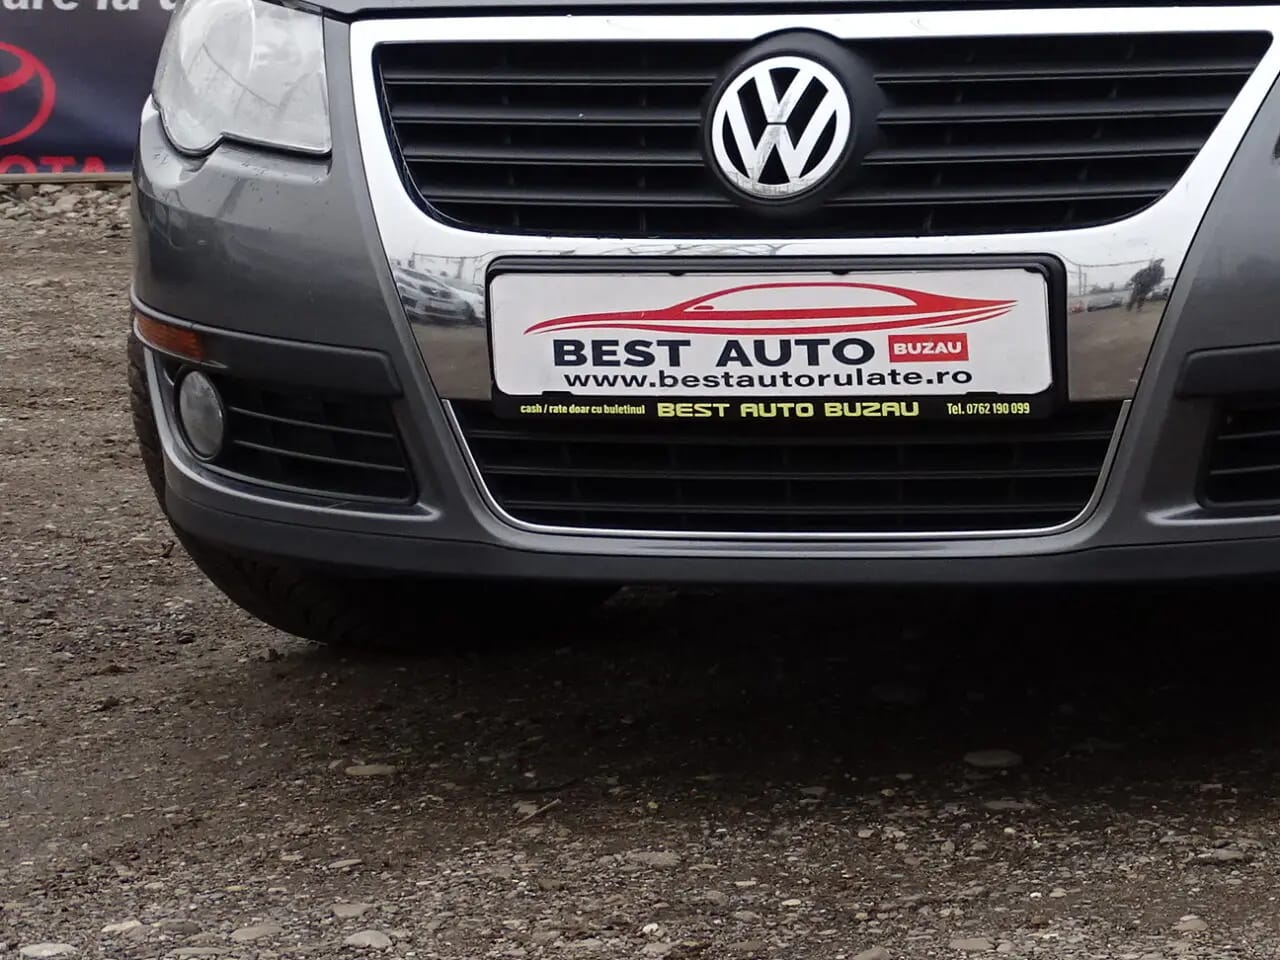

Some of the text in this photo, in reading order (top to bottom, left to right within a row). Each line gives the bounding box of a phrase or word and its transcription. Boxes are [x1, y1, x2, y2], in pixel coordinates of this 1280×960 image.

[552, 337, 962, 367] BEST AUTO BUZAU
[564, 368, 973, 388] www.bestautorulate.ro
[520, 403, 542, 414] cash
[549, 404, 568, 414] rate
[568, 403, 590, 415] doar
[591, 405, 603, 415] cu
[603, 403, 646, 415] buletinul
[657, 402, 730, 417] BEST
[740, 402, 815, 417] AUTO
[824, 401, 920, 417] BUZAU
[947, 402, 965, 415] Tel.
[966, 402, 991, 415] 0762
[992, 402, 1010, 415] 190
[1010, 402, 1030, 415] 099
